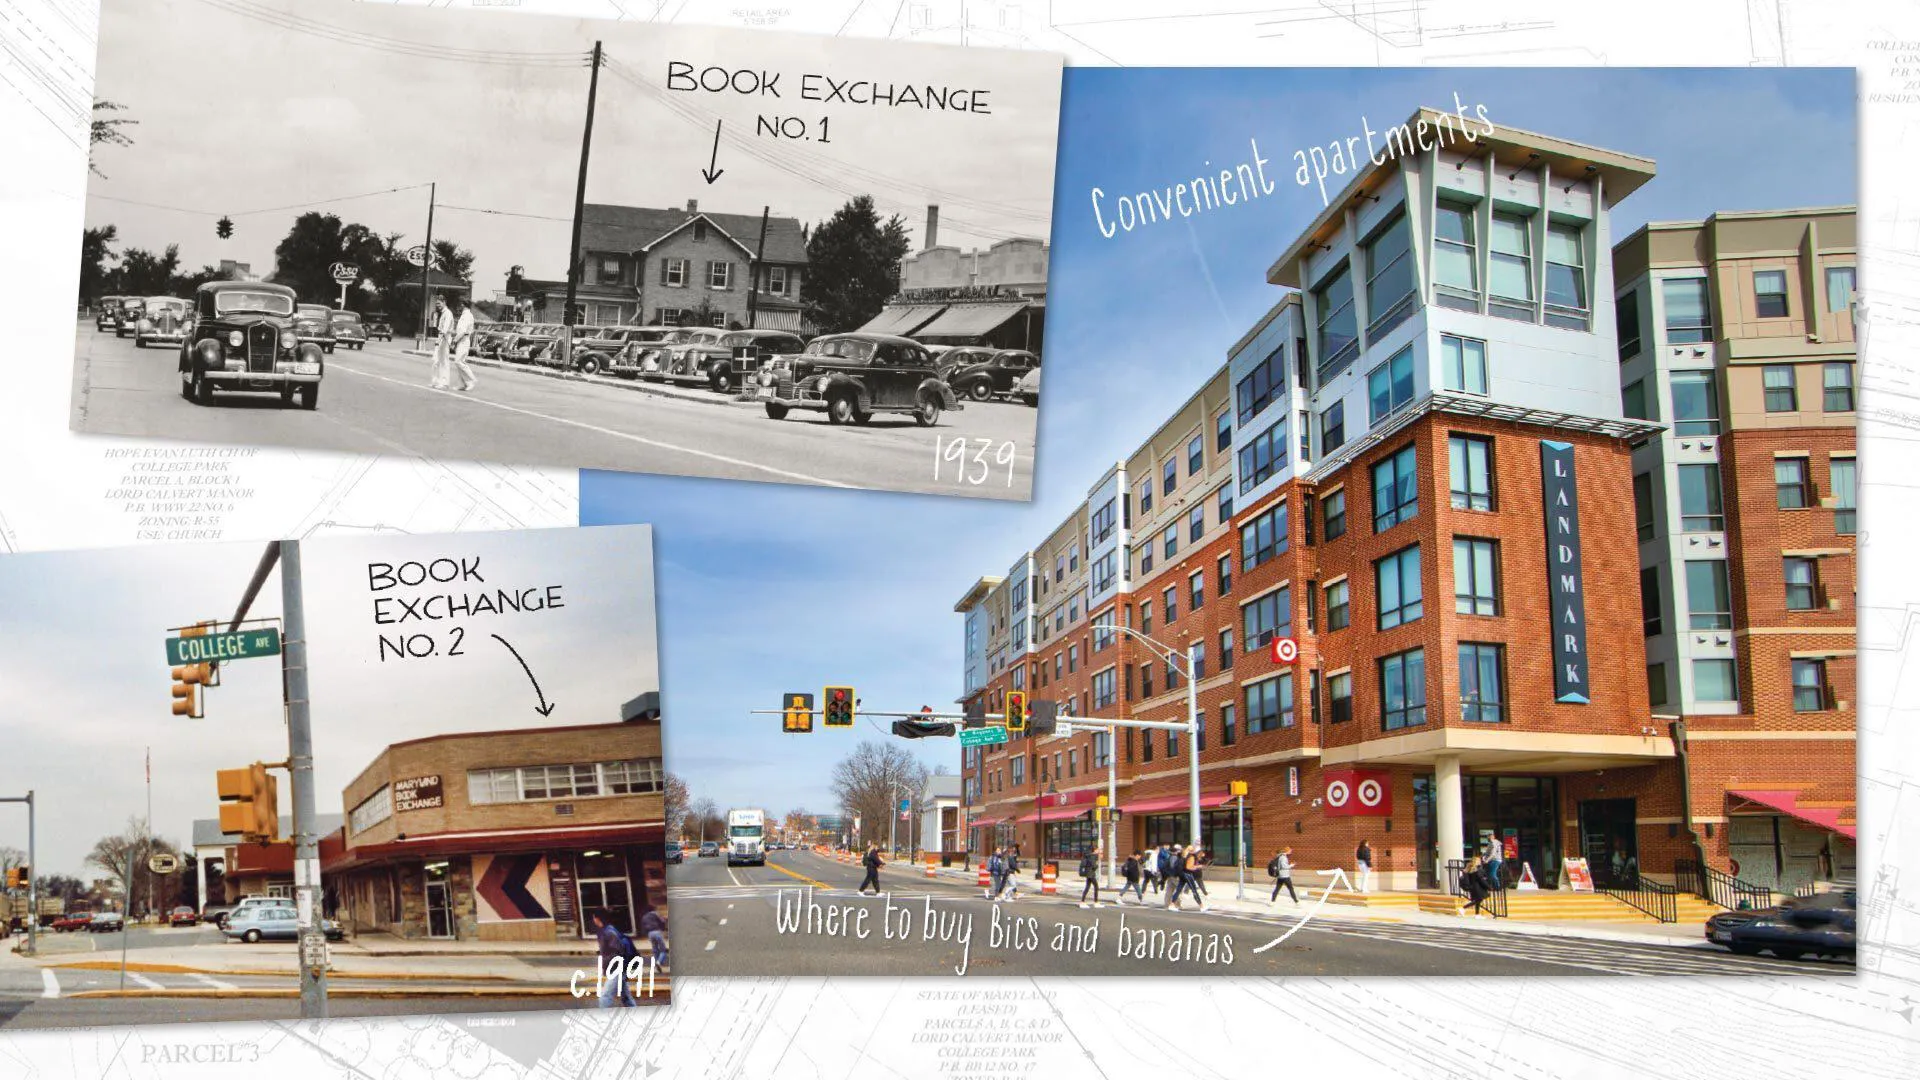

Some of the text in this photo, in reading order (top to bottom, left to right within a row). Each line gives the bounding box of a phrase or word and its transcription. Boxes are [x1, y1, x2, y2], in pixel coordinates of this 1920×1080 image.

[333, 263, 359, 279] Esso
[104, 448, 141, 458] HOPE
[240, 447, 260, 457] OF
[132, 462, 229, 472] COLLEGE PARK
[120, 475, 172, 486] PARCEL
[188, 475, 231, 485] BLOCK
[104, 488, 255, 499] LORD CALVERT MANOR
[167, 529, 224, 539] CHURCH
[1554, 459, 1581, 684] LANDMARK
[178, 635, 270, 661] COLLEGE AVE
[395, 776, 439, 790] MARYLAND
[395, 789, 418, 801] BOOK
[396, 796, 441, 811] EXCHANGE
[916, 990, 1058, 1000] STATE OF MARYLAND
[924, 1019, 983, 1029] PARCELS
[1040, 1019, 1051, 1029] D
[911, 1033, 1064, 1043] LORD CALVERT MANOR
[141, 1043, 242, 1063] PARCEL
[249, 1043, 260, 1063] 3
[937, 1047, 1038, 1058] COLLEGE PARK
